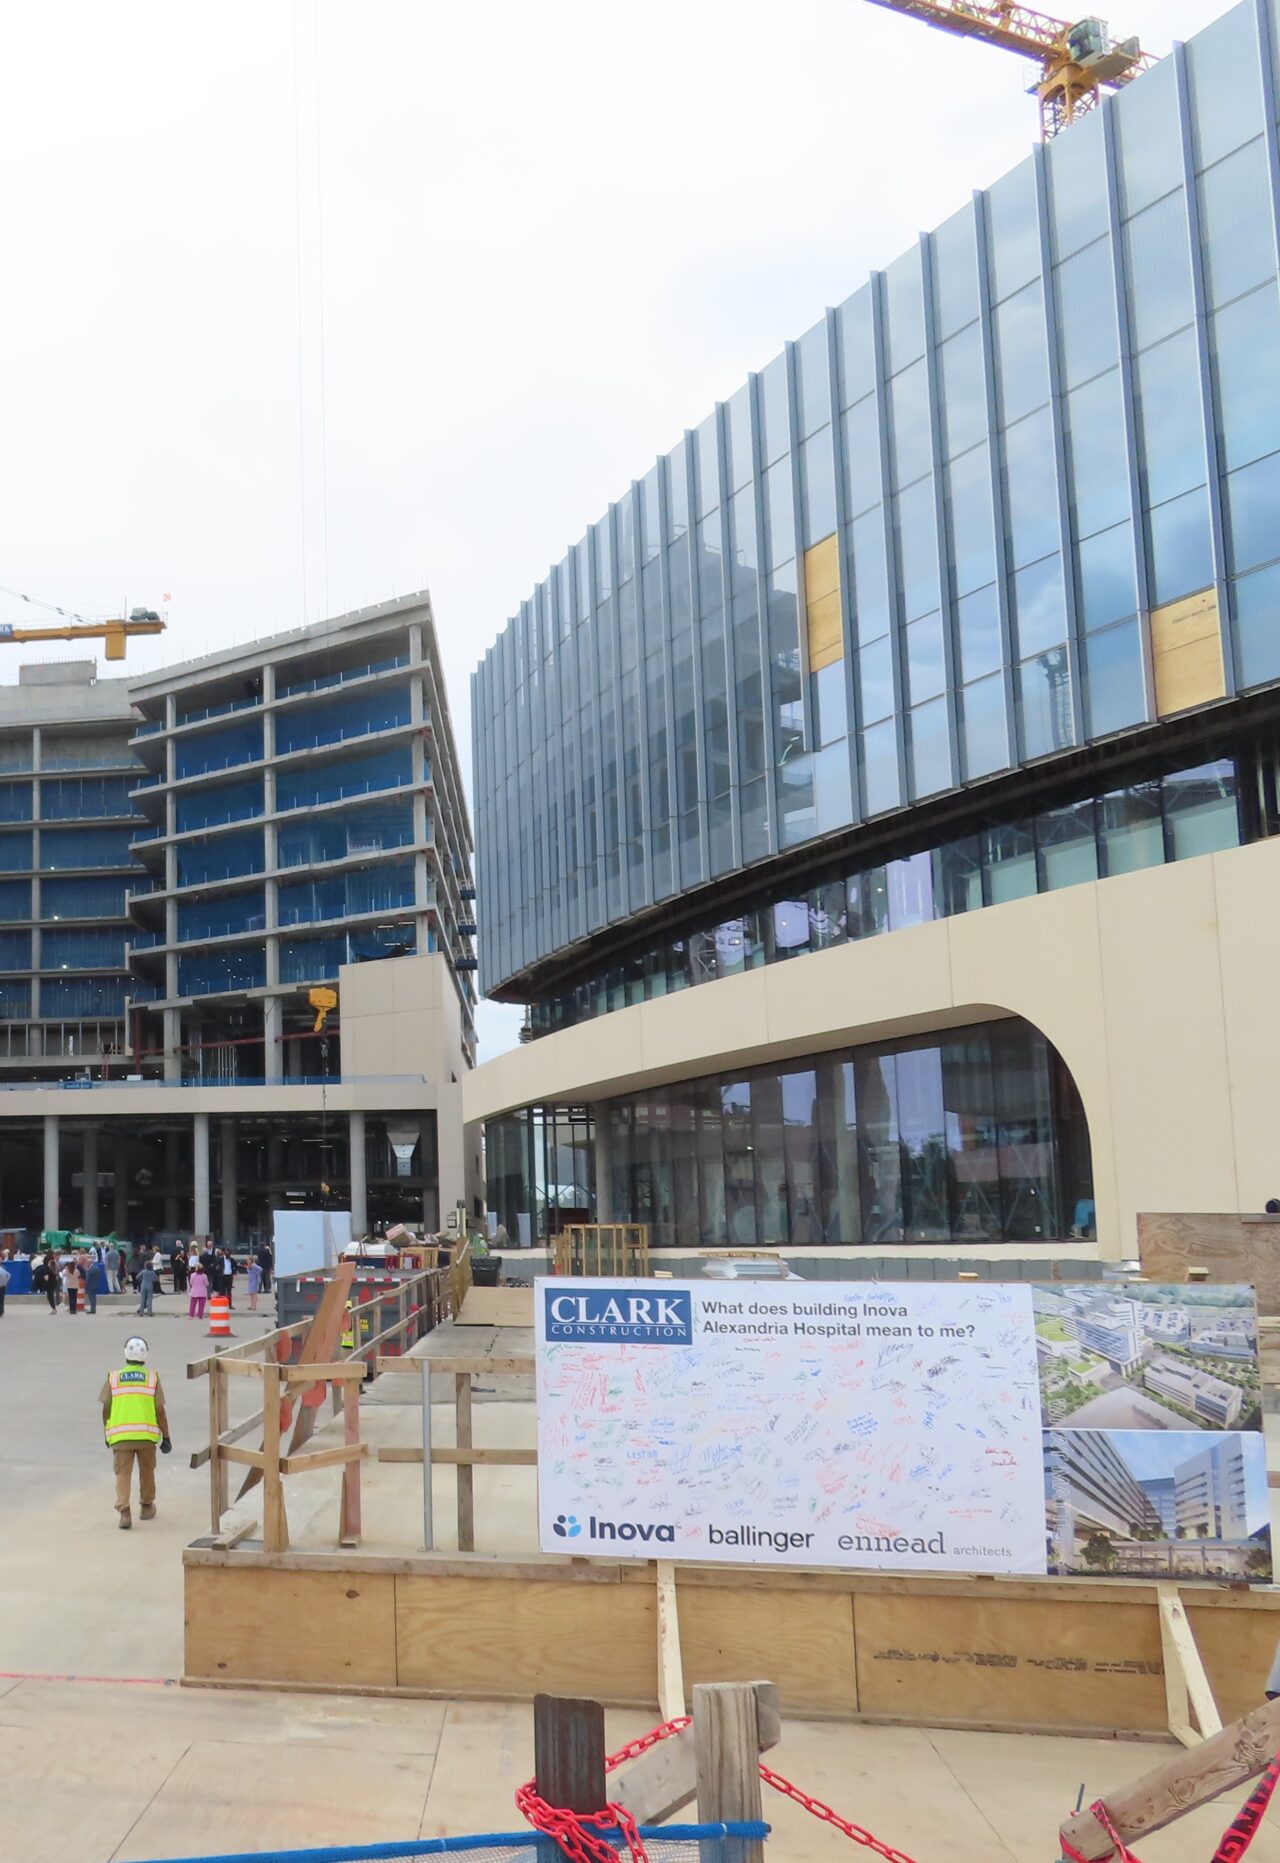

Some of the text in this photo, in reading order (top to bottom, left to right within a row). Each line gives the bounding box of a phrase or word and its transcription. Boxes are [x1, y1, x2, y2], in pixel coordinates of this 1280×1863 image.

[551, 1296, 686, 1325] CLARK
[702, 1301, 908, 1318] What does building Inova
[551, 1325, 687, 1337] CONSTRUCTION
[703, 1321, 975, 1338] Alexandria Hospital mean to me?
[120, 1372, 145, 1380] CLARK
[590, 1516, 1012, 1557] Inova ballinger ennead architects
